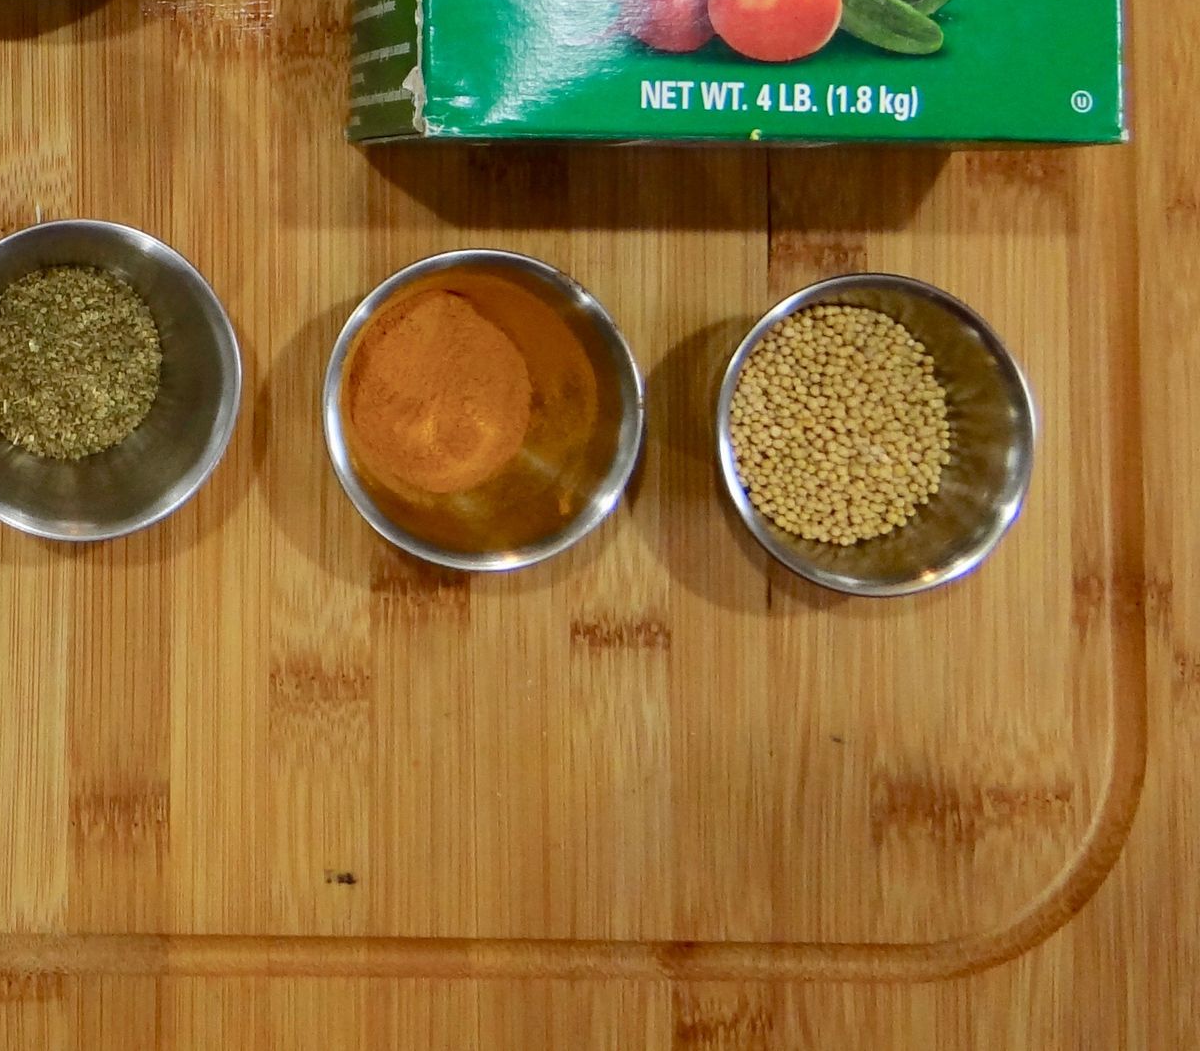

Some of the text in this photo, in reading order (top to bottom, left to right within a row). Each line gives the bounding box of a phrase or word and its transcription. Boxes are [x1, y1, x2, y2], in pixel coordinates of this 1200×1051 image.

[640, 80, 919, 122] NET WT. 4 LB. (1.8 kg)
